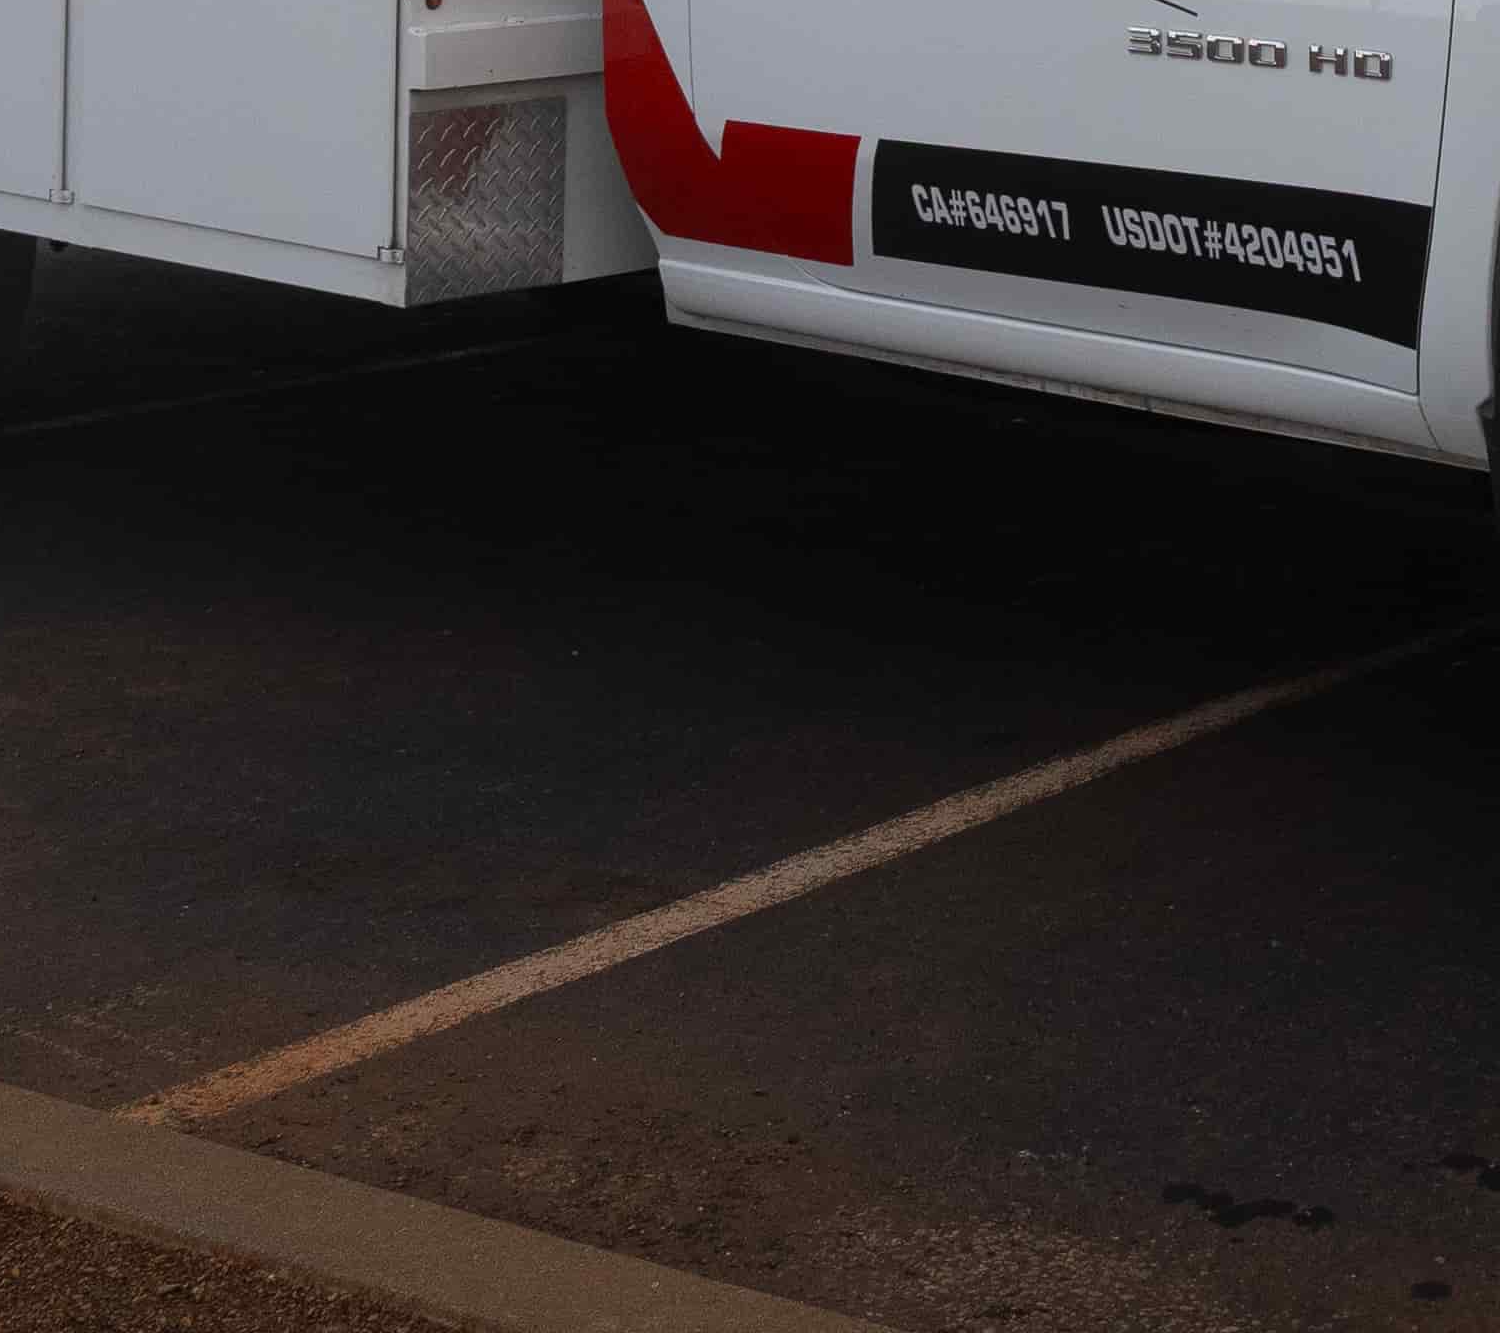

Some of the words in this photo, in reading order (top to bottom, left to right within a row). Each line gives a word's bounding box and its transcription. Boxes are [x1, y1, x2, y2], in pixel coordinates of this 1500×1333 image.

[1126, 26, 1288, 69] 3500
[1307, 44, 1394, 83] HD
[910, 183, 1071, 241] CA#646917
[1100, 205, 1362, 284] USDOT#4204951
